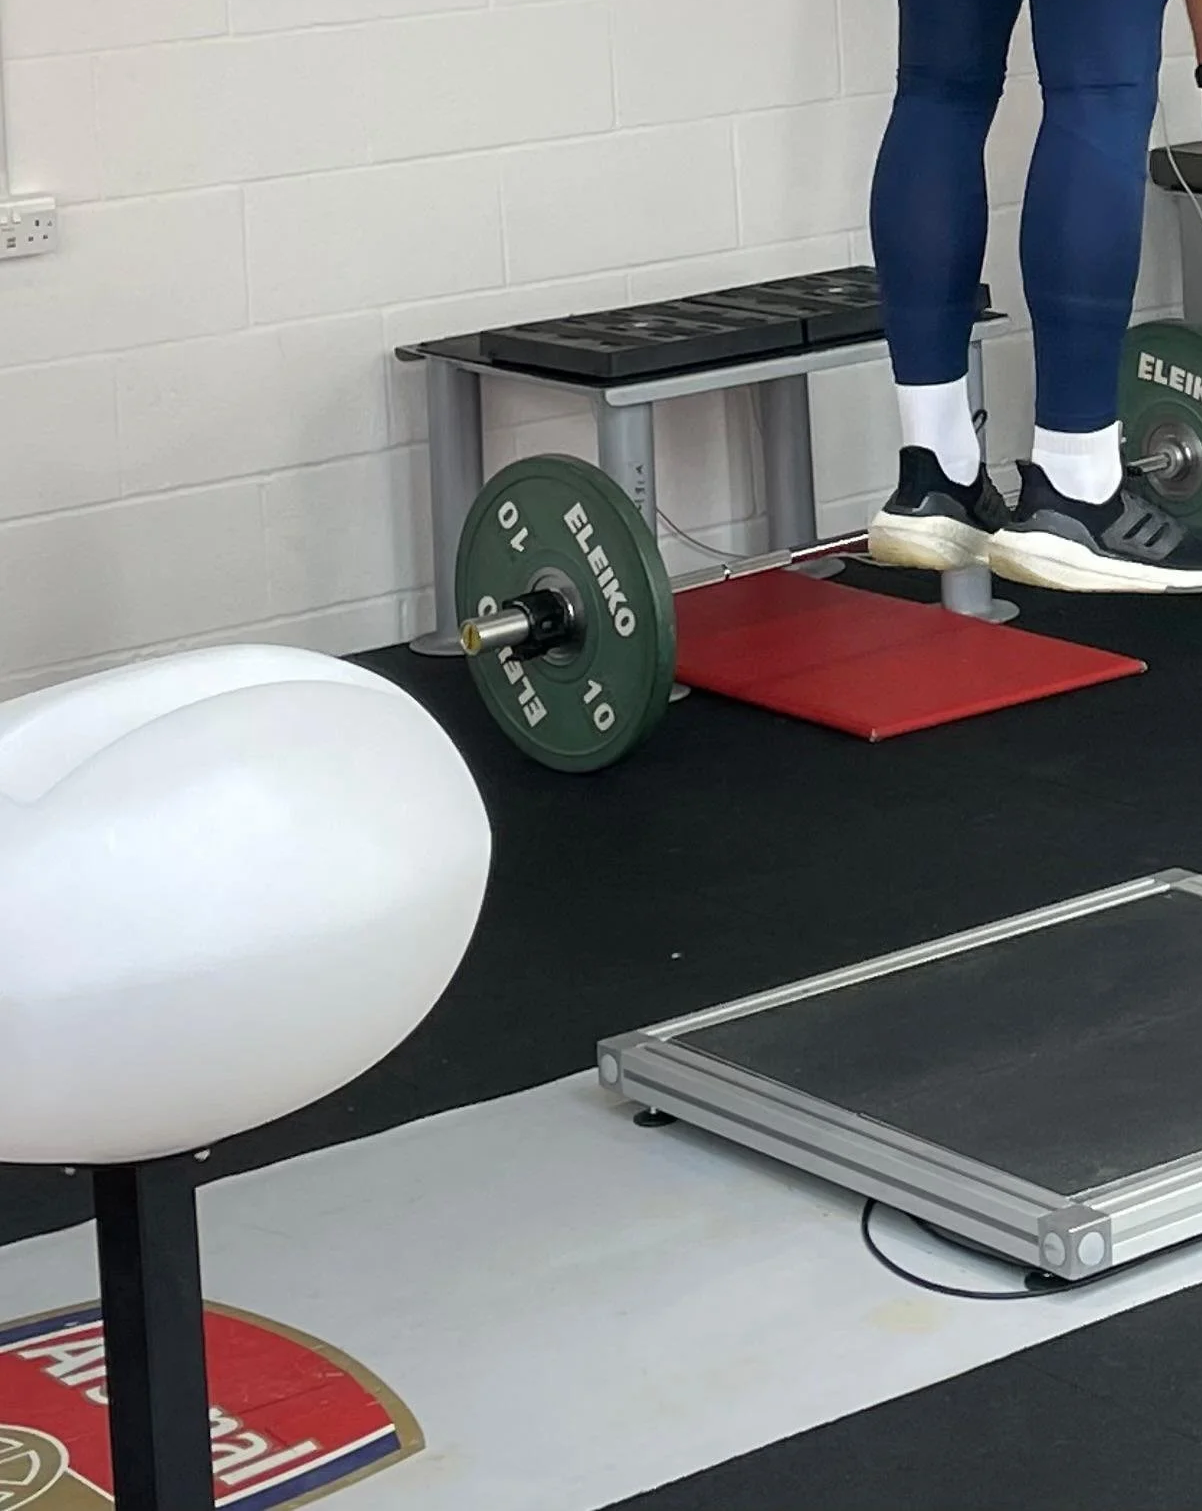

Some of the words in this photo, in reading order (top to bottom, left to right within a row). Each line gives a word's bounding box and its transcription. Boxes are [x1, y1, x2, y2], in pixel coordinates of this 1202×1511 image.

[498, 500, 529, 553] 10
[563, 502, 636, 637] ELEIKO
[583, 679, 616, 732] 10
